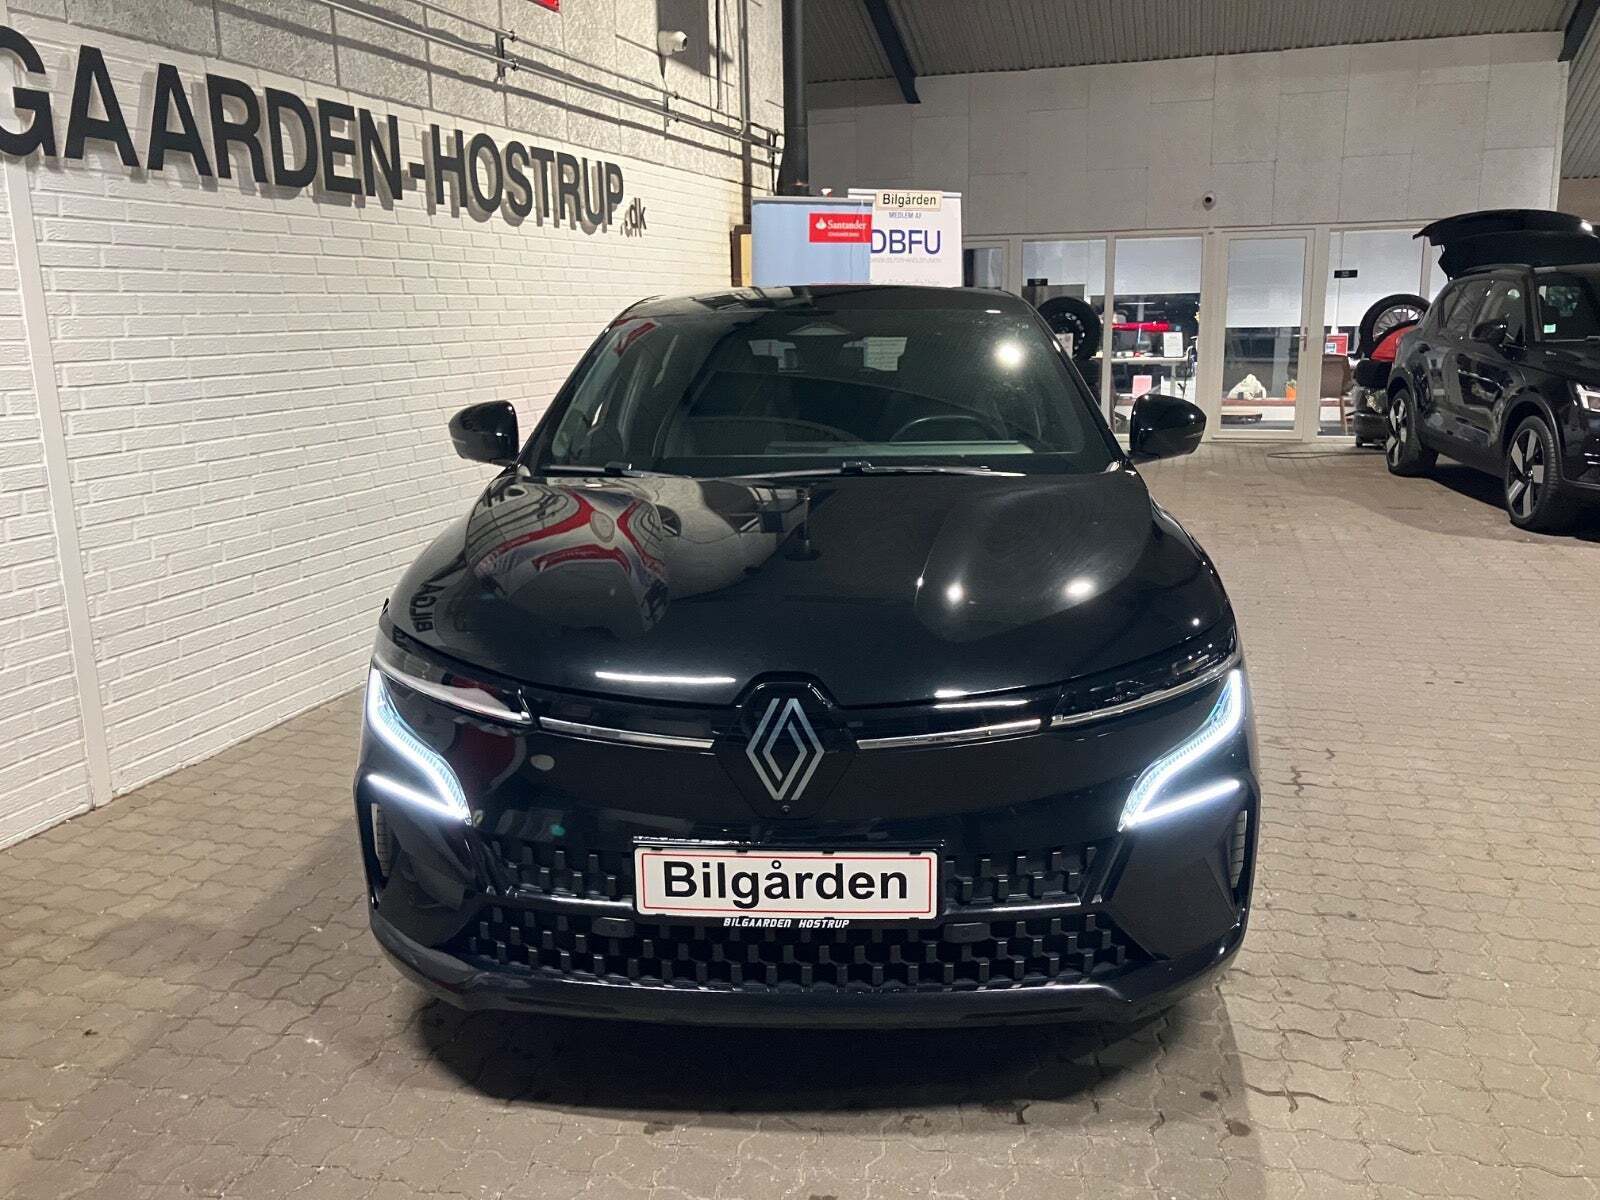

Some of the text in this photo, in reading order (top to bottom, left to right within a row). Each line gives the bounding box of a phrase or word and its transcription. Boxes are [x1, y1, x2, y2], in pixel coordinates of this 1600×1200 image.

[883, 193, 937, 208] Bilgården
[827, 219, 867, 230] Santander
[870, 229, 941, 255] DBFU
[663, 859, 908, 909] Bilgården
[723, 917, 850, 930] BILGAARDEN HOSTRUP
